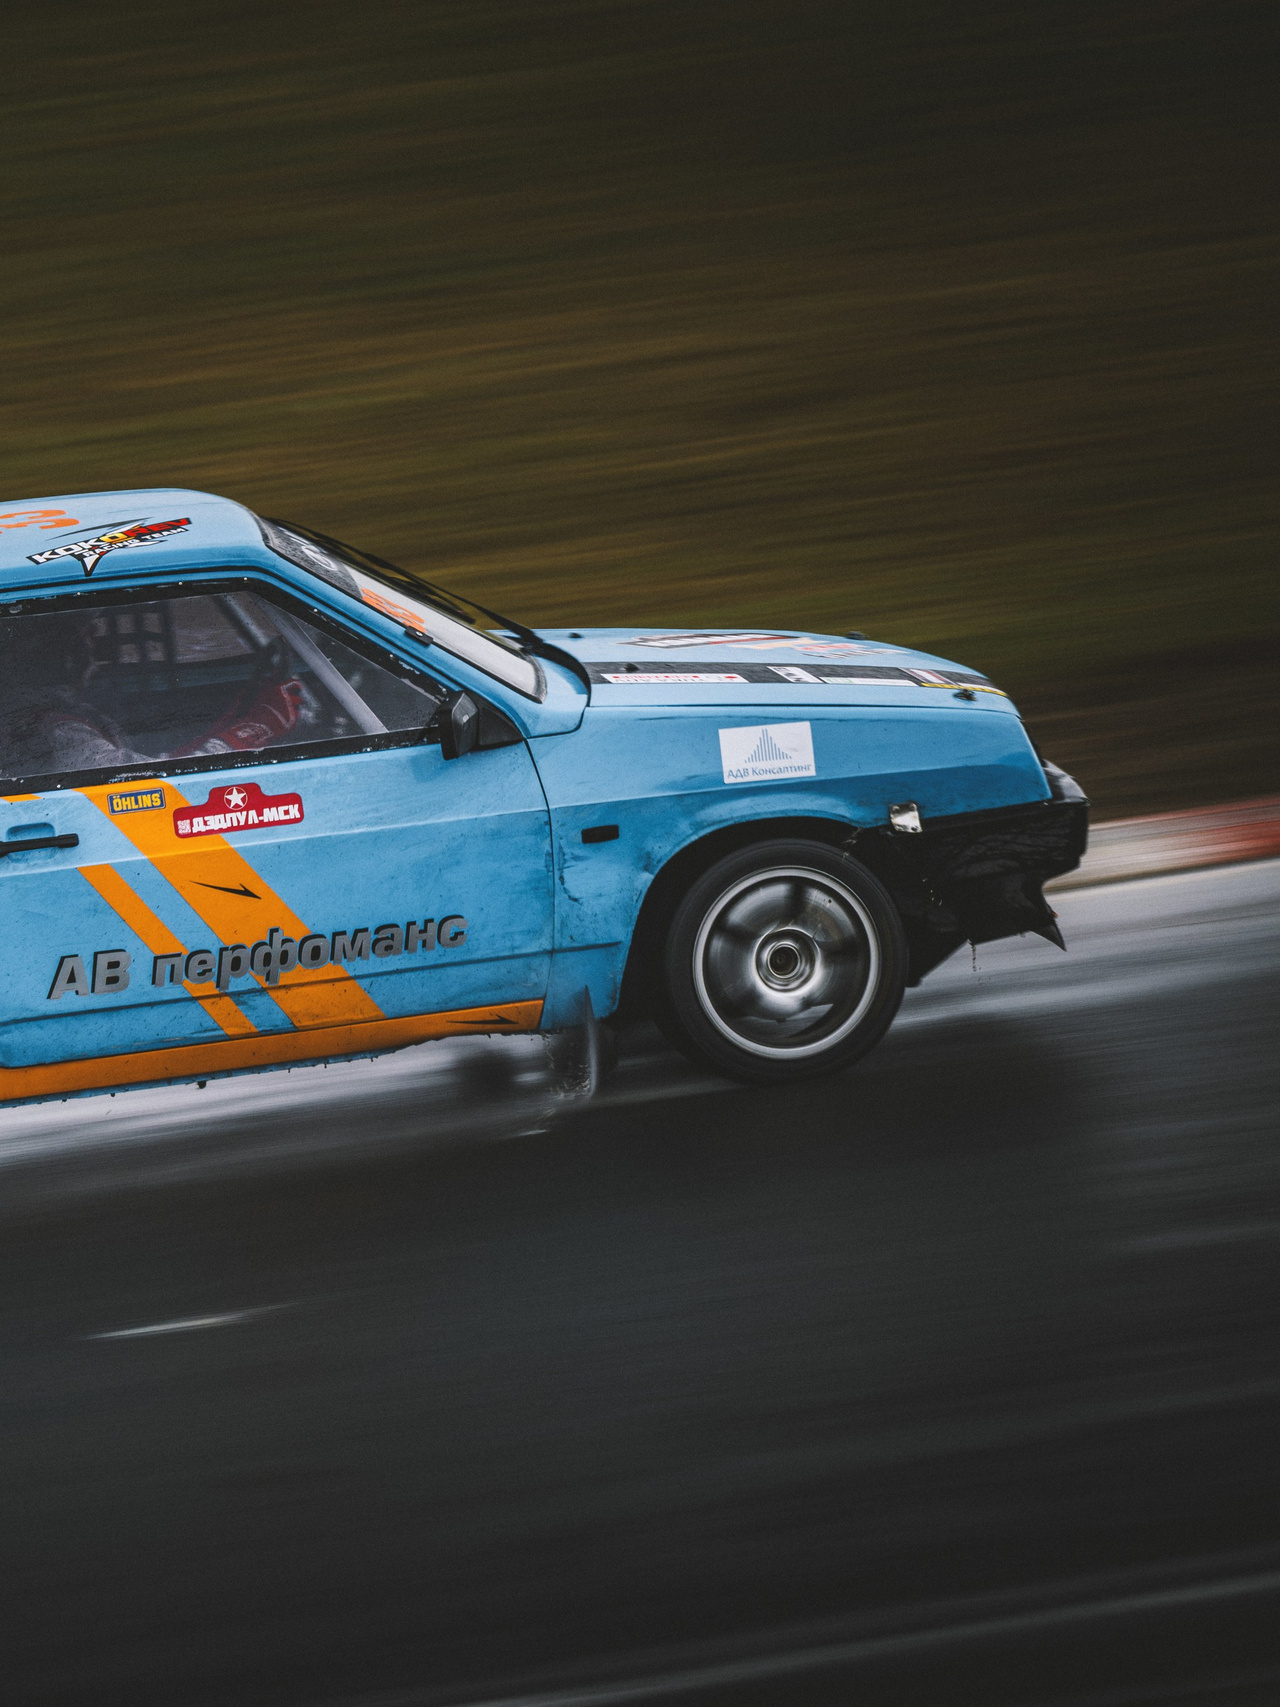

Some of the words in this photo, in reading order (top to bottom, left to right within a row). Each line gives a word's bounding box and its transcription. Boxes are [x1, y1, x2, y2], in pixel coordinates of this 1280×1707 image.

[32, 518, 190, 563] KOKOREV
[83, 537, 138, 557] RACING
[140, 527, 187, 541] TEAM
[727, 768, 750, 779] АДВ
[751, 764, 812, 777] Консалтинг
[113, 793, 162, 811] ÖHLINS
[192, 803, 301, 833] ДЭДПУЛ-МСК
[47, 949, 131, 1000] АВ
[151, 914, 469, 992] перфоманс
